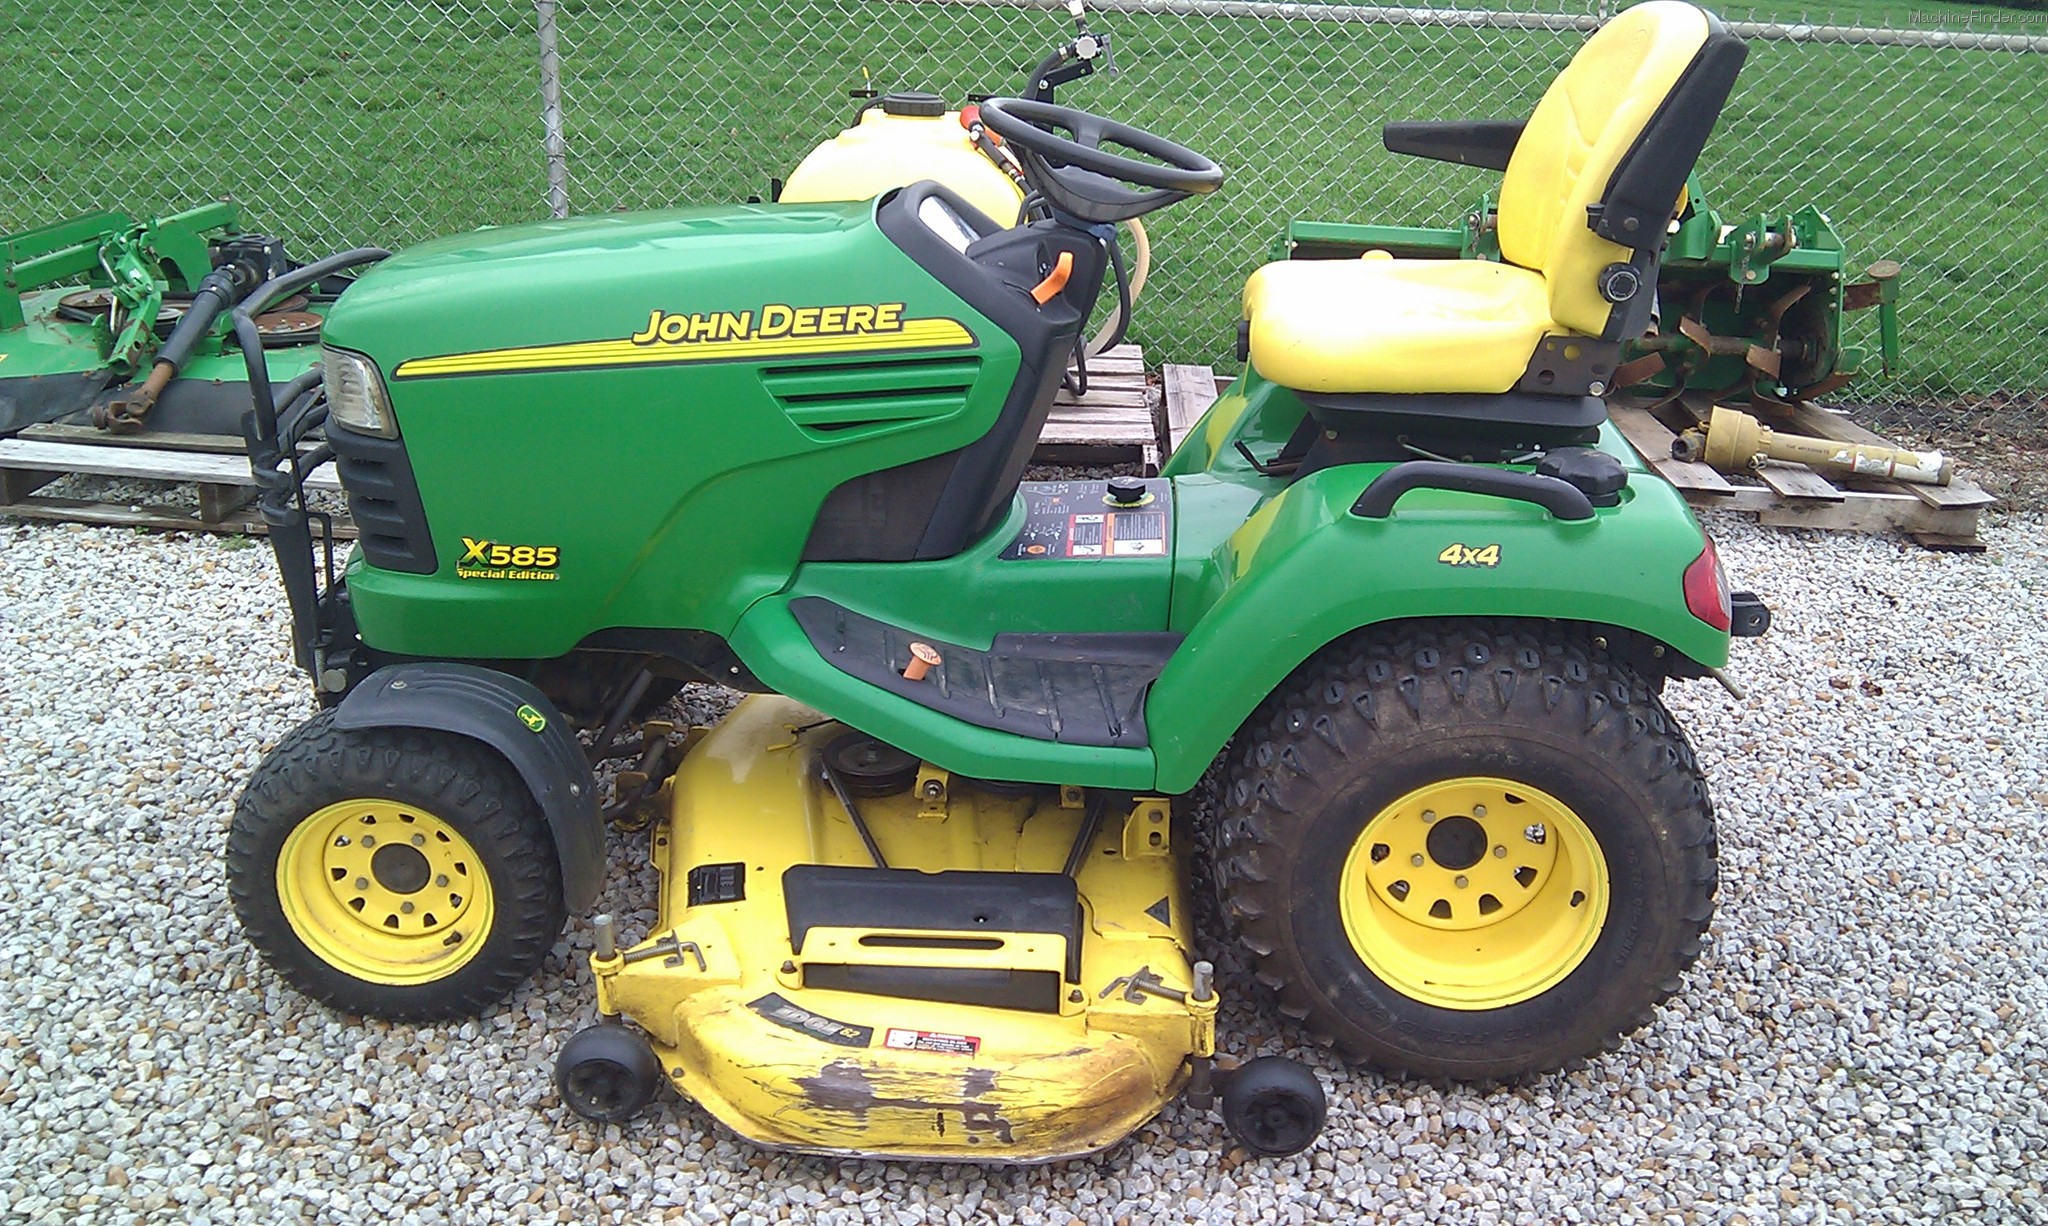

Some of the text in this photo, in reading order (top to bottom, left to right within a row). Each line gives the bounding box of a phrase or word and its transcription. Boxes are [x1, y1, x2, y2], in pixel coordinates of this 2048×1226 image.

[631, 303, 905, 345] JOHN DEERE
[458, 536, 559, 568] X585
[1438, 543, 1501, 568] 4x4
